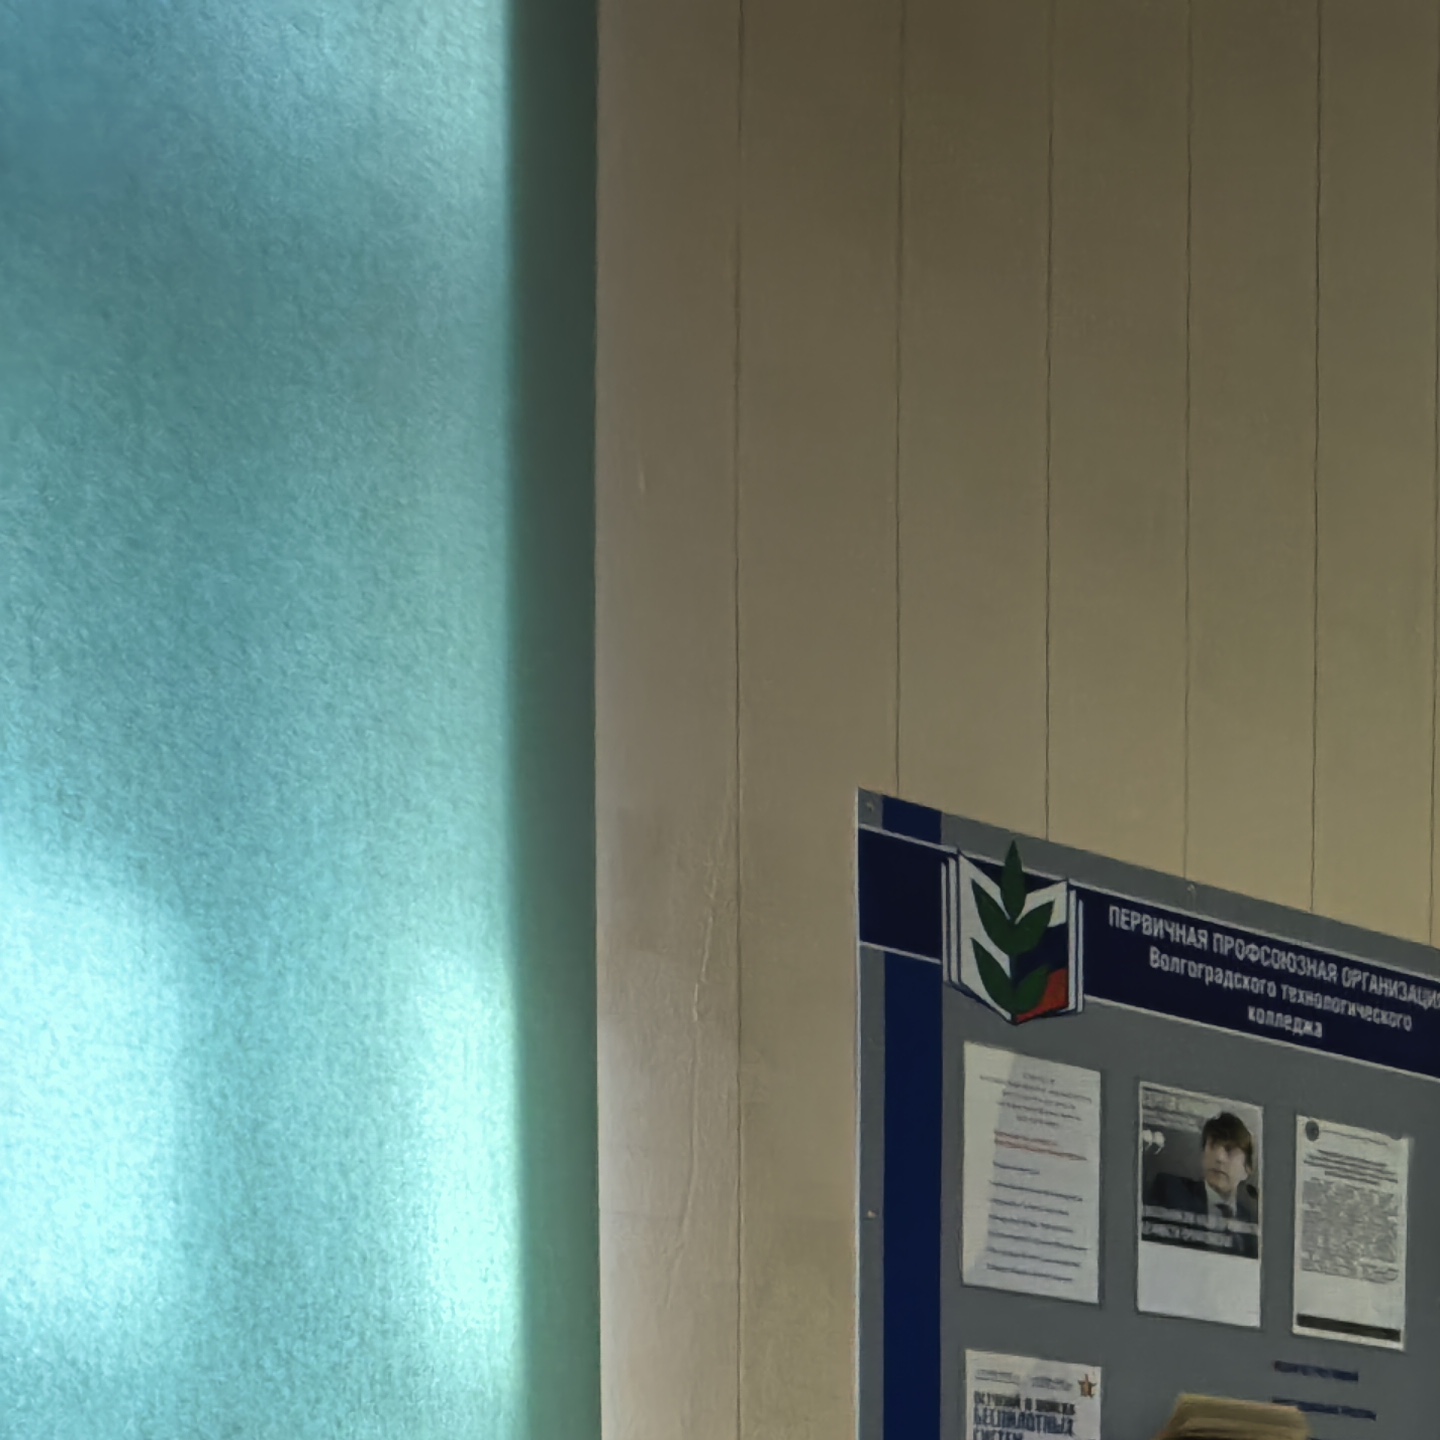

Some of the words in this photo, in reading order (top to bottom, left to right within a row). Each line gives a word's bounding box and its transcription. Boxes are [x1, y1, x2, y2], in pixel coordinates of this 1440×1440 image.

[1108, 905, 1209, 949] ПЕРВИЧНАЯ
[1212, 932, 1338, 983] ПРОФСОЮЗНАЯ
[1149, 945, 1277, 998] Волгоградского
[1281, 984, 1413, 1032] технологического
[1247, 1005, 1324, 1039] колледжа
